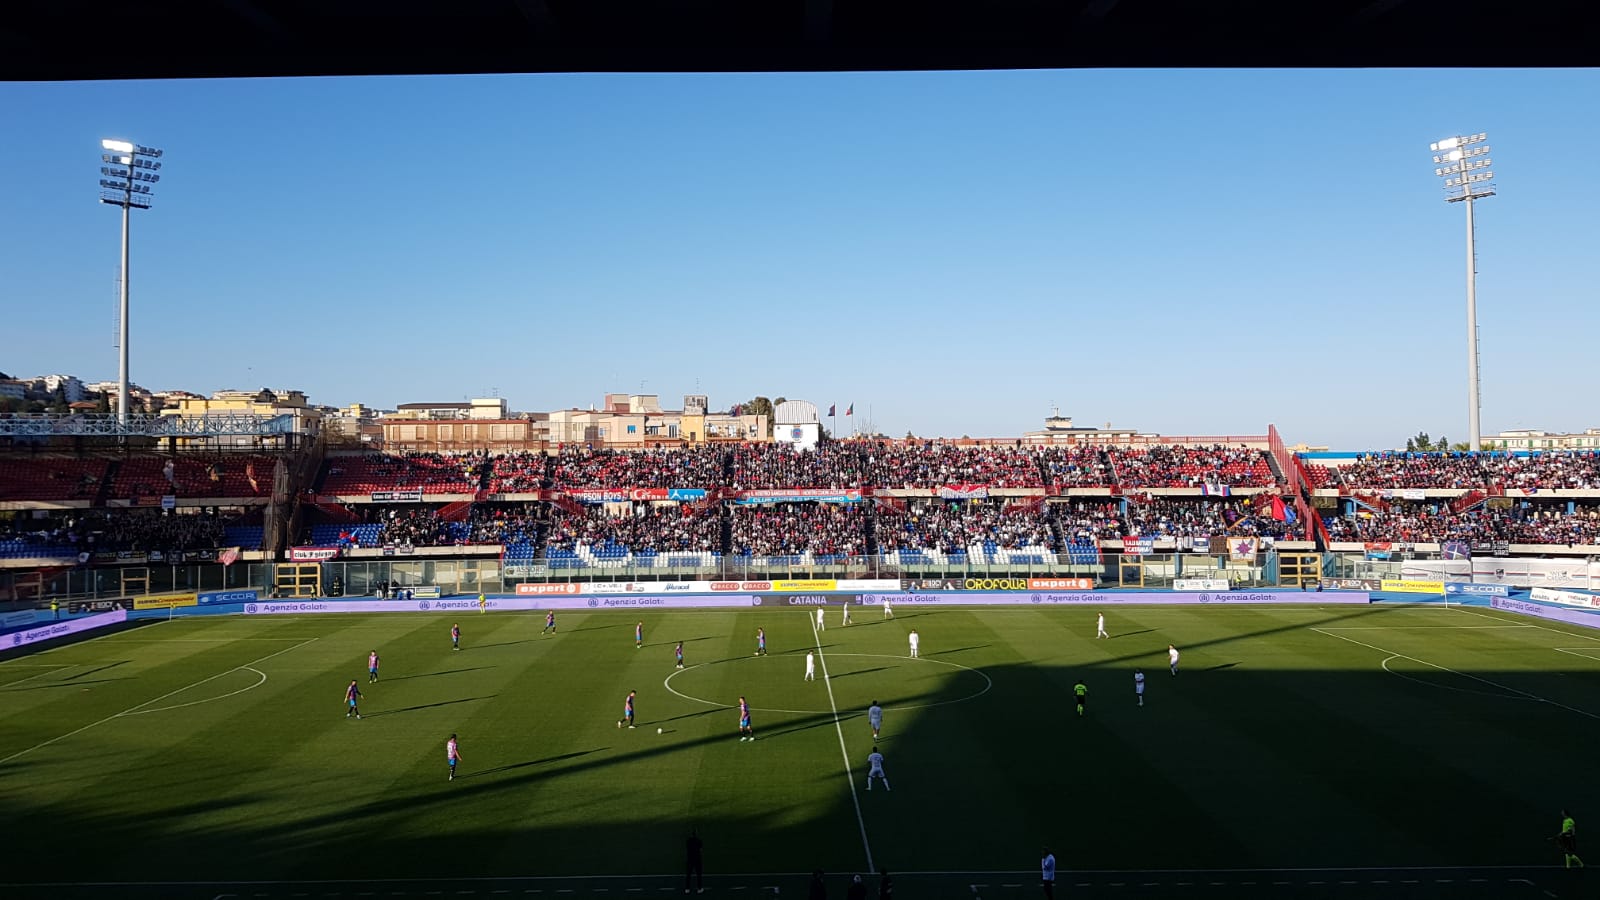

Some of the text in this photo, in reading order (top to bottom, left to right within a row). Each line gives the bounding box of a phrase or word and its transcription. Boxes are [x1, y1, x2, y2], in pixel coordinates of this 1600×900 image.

[603, 491, 622, 500] BOYS
[520, 584, 565, 593] expert
[1032, 579, 1077, 589] expert
[789, 595, 827, 604] CATANIA
[1047, 594, 1080, 602] Agenzia
[1214, 594, 1248, 602] Agenzia
[263, 604, 298, 612] Agenzia
[435, 601, 468, 609] Agenzia
[1501, 600, 1524, 610] Agenzia
[25, 629, 51, 641] Agenzia
